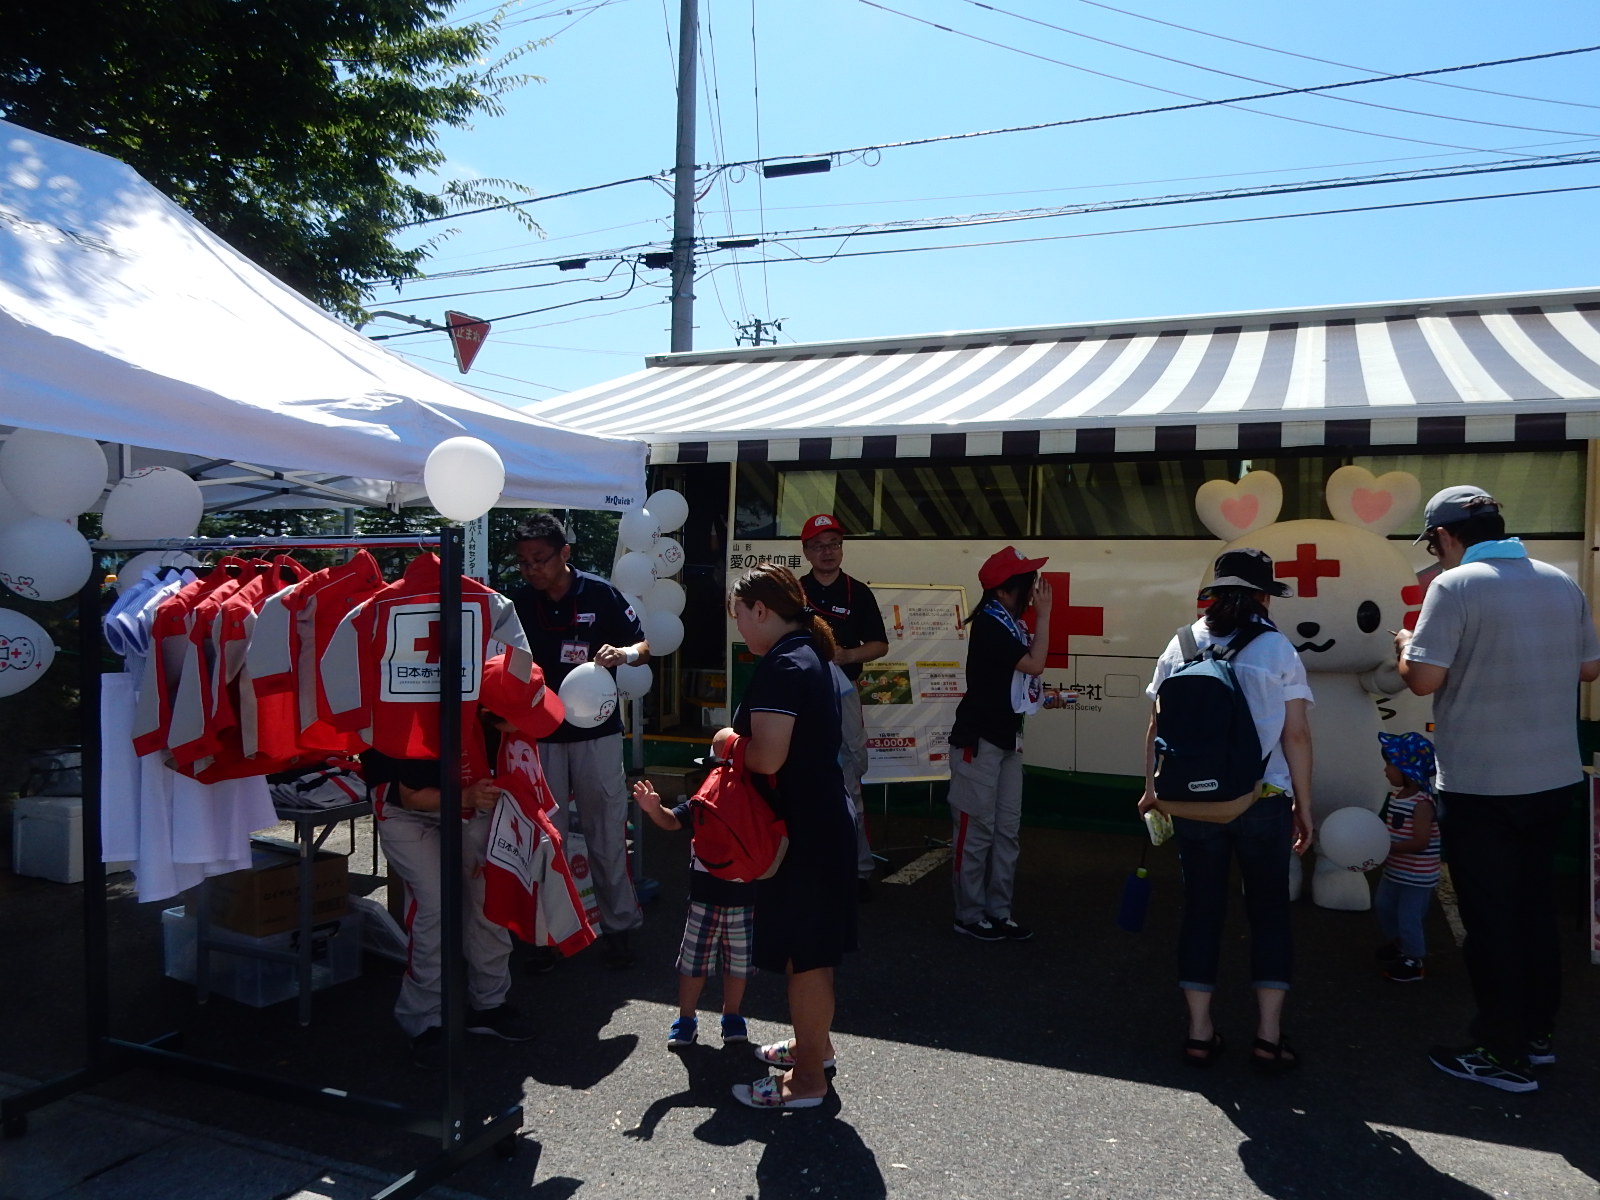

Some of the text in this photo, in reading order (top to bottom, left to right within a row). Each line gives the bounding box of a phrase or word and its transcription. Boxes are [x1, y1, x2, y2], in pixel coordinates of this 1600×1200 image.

[456, 327, 481, 343] 止まれ
[1076, 702, 1102, 713] Society
